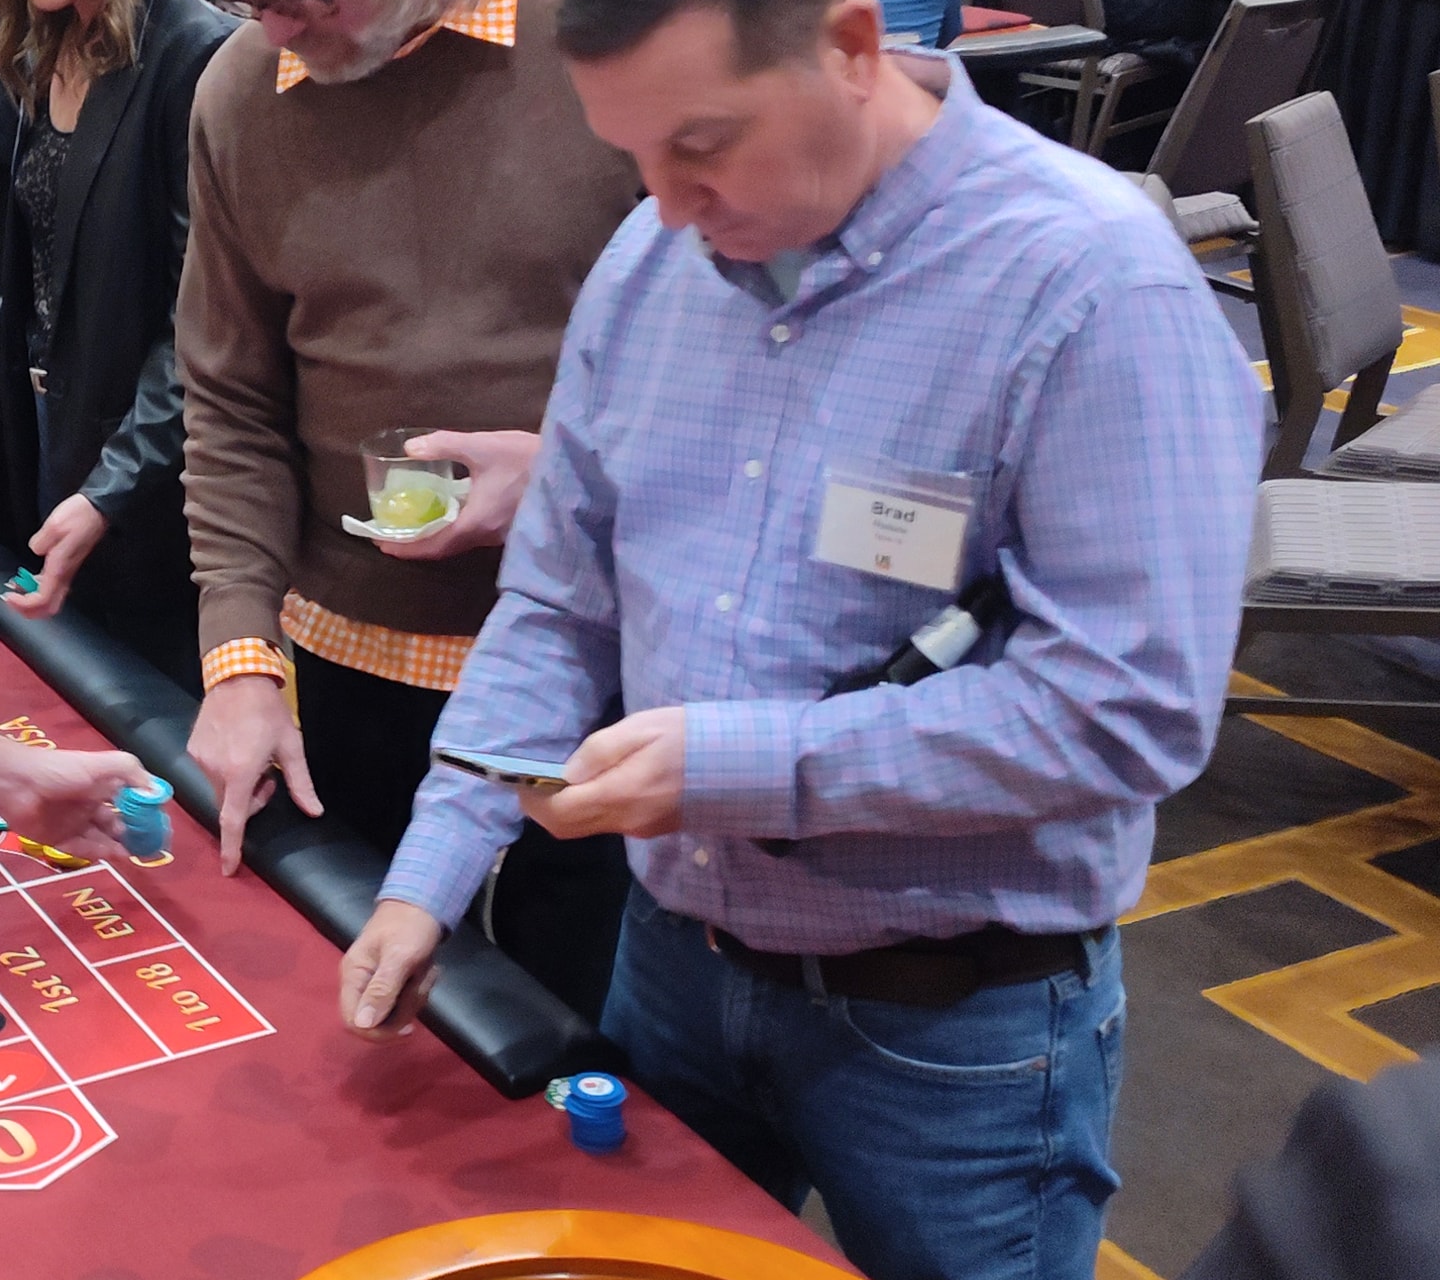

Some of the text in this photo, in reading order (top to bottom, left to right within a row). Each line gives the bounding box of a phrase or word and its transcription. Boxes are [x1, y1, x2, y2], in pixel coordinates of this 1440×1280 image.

[871, 501, 916, 523] Brad
[63, 886, 135, 940] EVEN
[31, 974, 80, 1013] 1st
[135, 962, 222, 1032] 1 to 18
